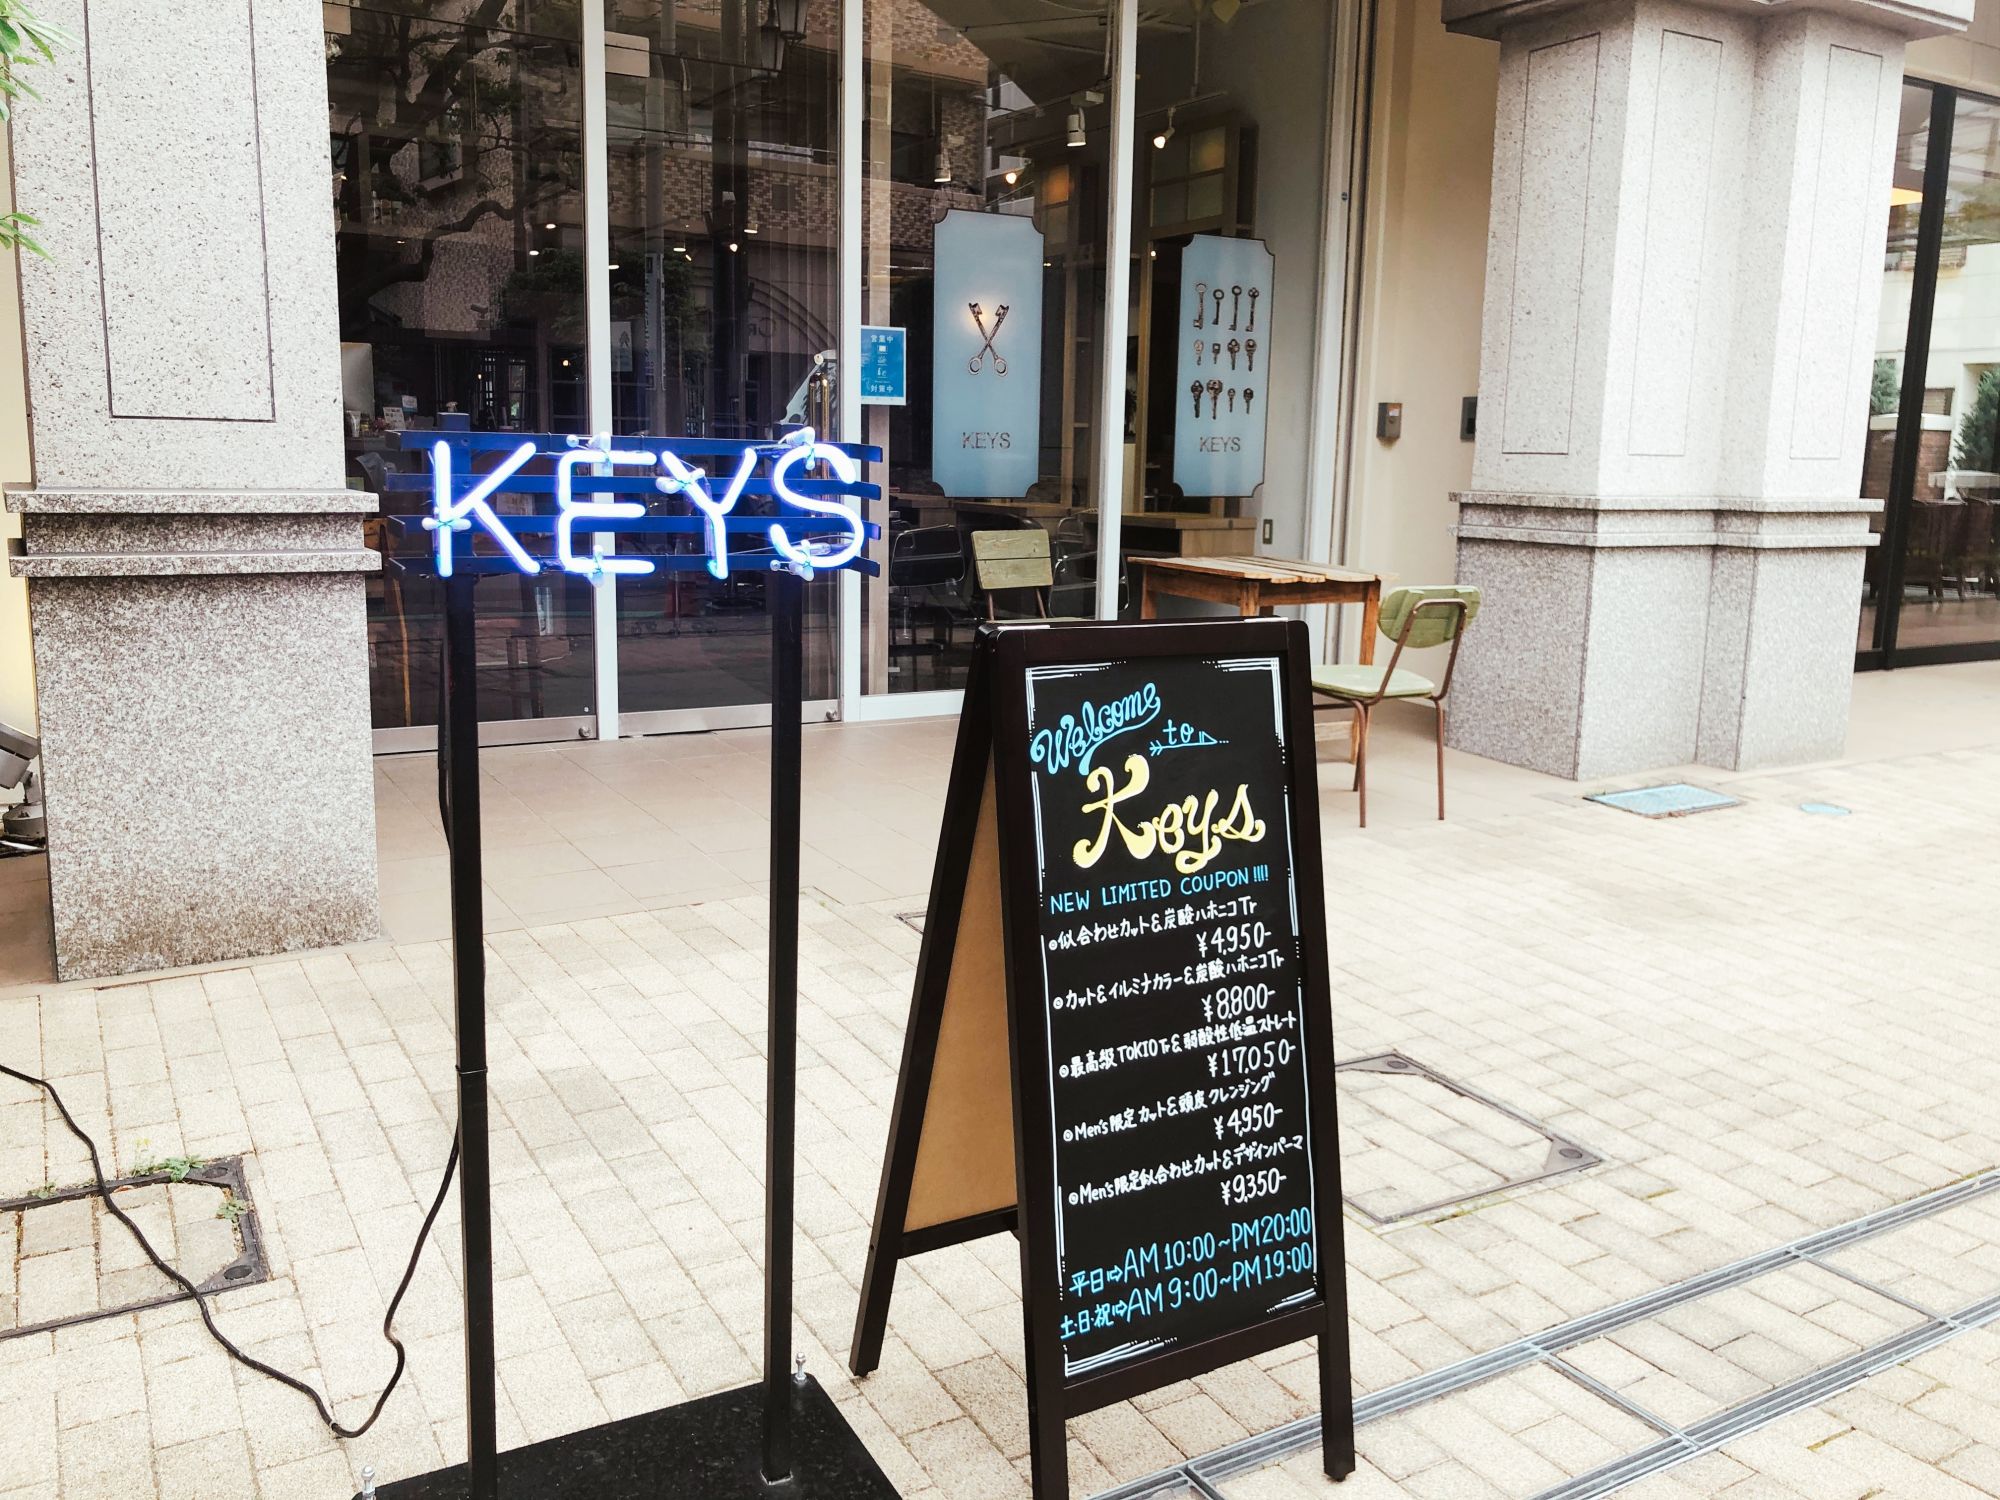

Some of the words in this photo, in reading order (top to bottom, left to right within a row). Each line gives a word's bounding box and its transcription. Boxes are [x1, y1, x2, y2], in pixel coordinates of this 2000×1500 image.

[962, 432, 1011, 449] KEYS
[1200, 436, 1242, 453] KEYS
[434, 439, 865, 579] KEYS
[1030, 682, 1161, 775] Welcome
[1162, 719, 1195, 744] to
[1073, 753, 1266, 874] Keys
[1049, 893, 1090, 915] NEW
[1102, 880, 1172, 907] LIMITED
[1180, 867, 1249, 895] COUPON
